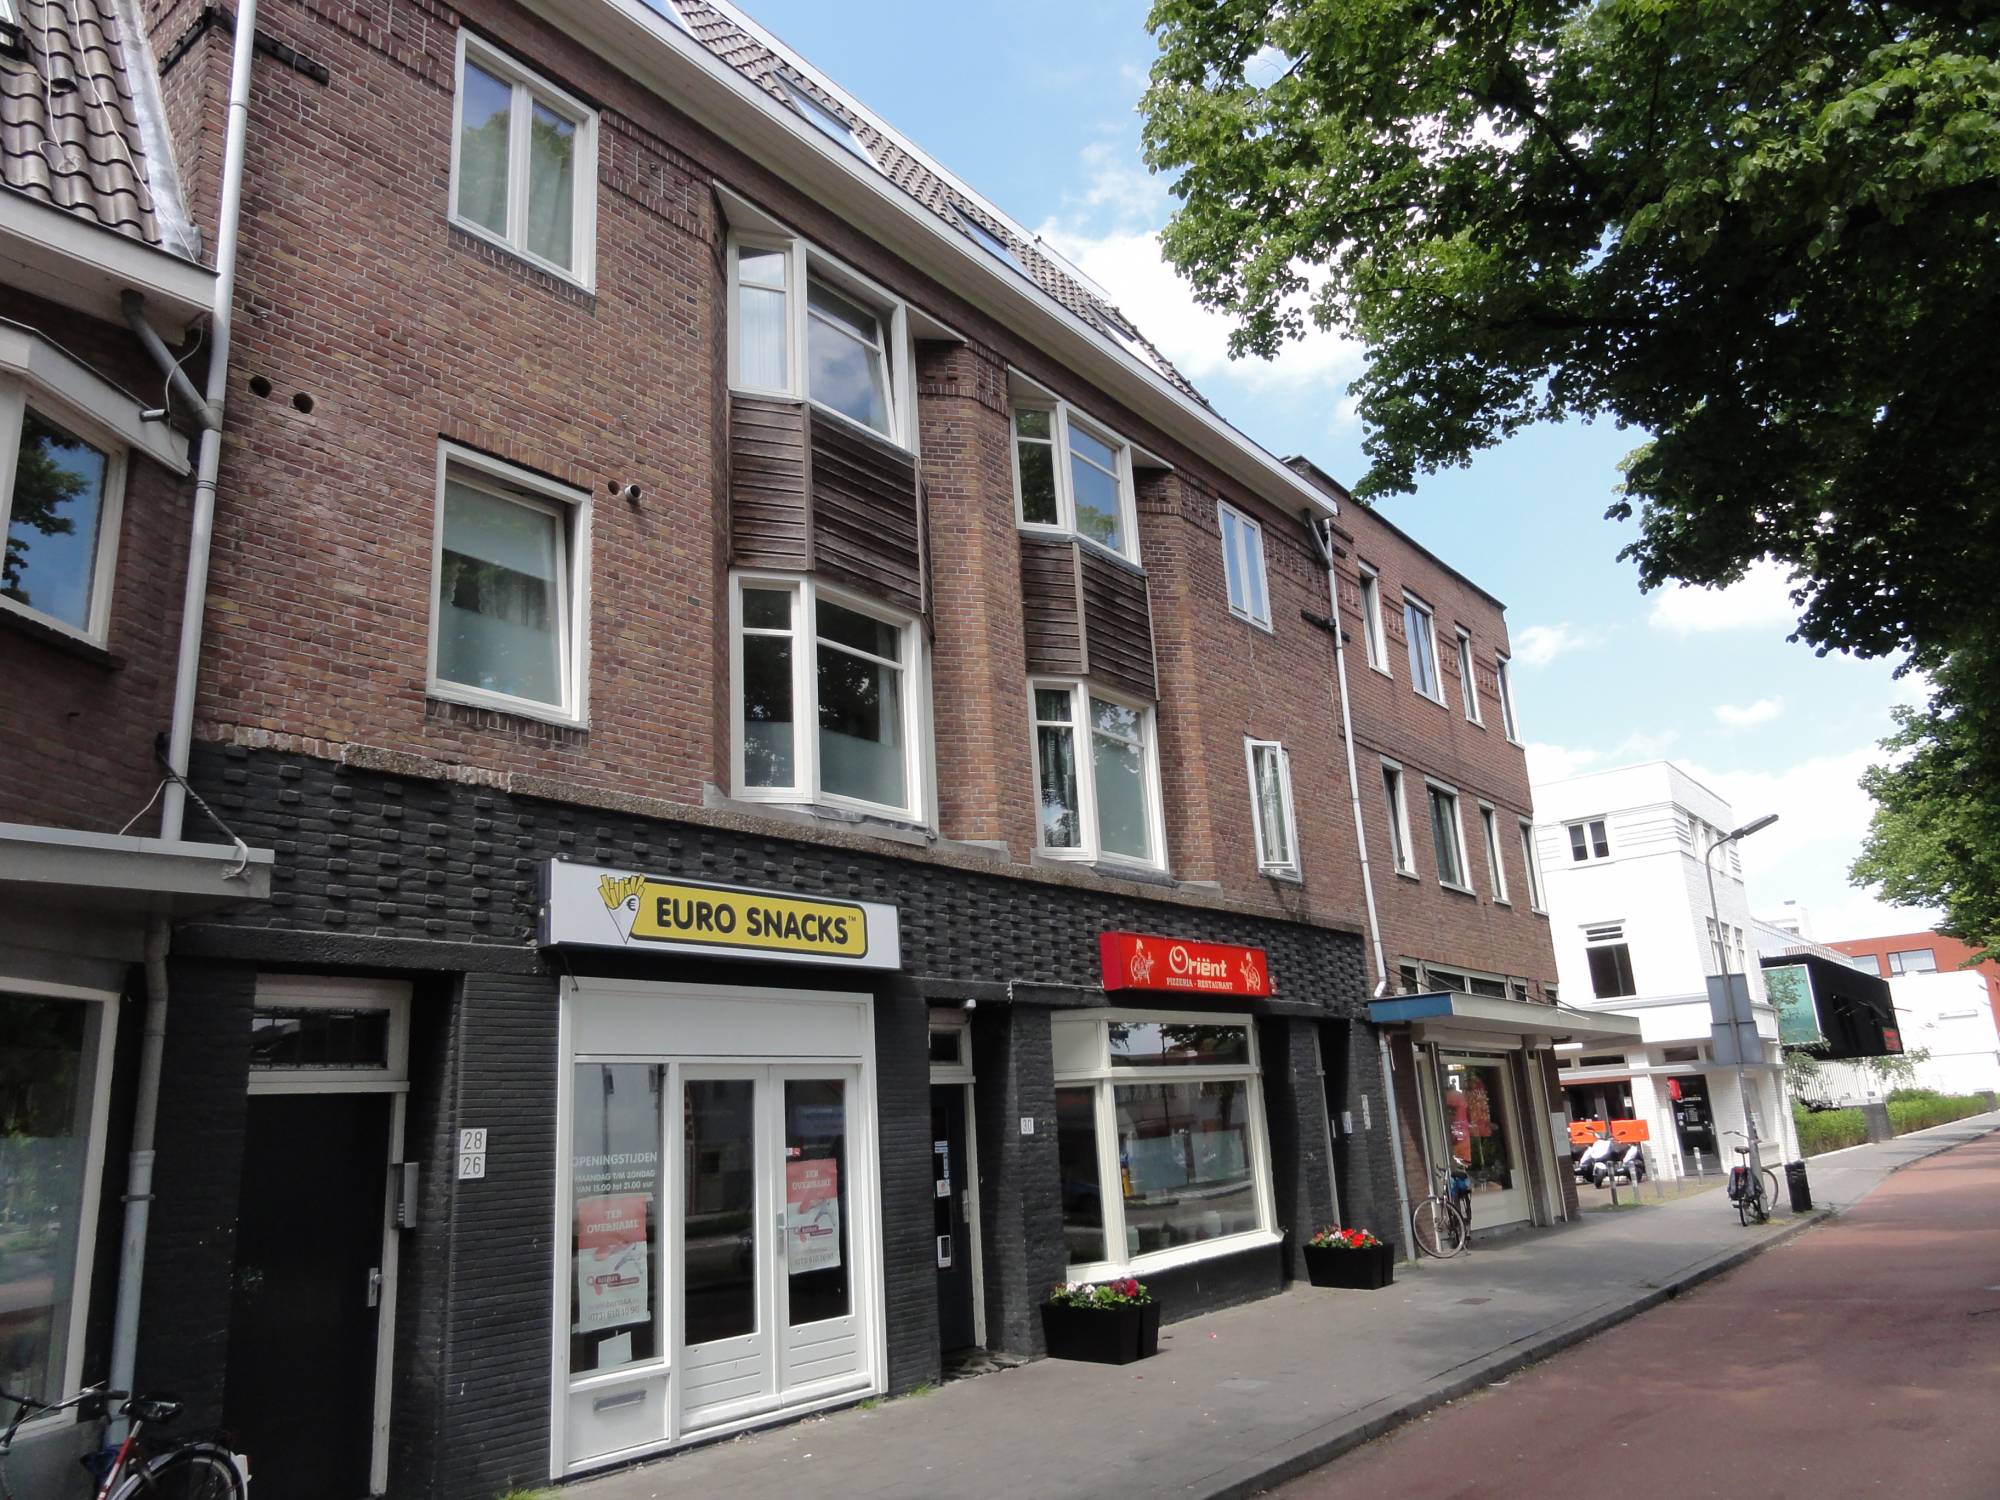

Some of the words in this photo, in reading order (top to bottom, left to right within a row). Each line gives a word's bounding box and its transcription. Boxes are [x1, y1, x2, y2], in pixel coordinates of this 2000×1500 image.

[656, 896, 736, 933] EURO
[746, 907, 848, 945] SNACKS
[1168, 945, 1227, 978] Oriënt
[1166, 977, 1193, 988] PIZZERIA
[1197, 979, 1232, 989] RESTAURANT
[1022, 1118, 1032, 1132] 30
[464, 1131, 482, 1150] 28
[463, 1156, 481, 1175] 26
[626, 1169, 656, 1179] ZONDAG
[576, 1184, 591, 1193] VAN
